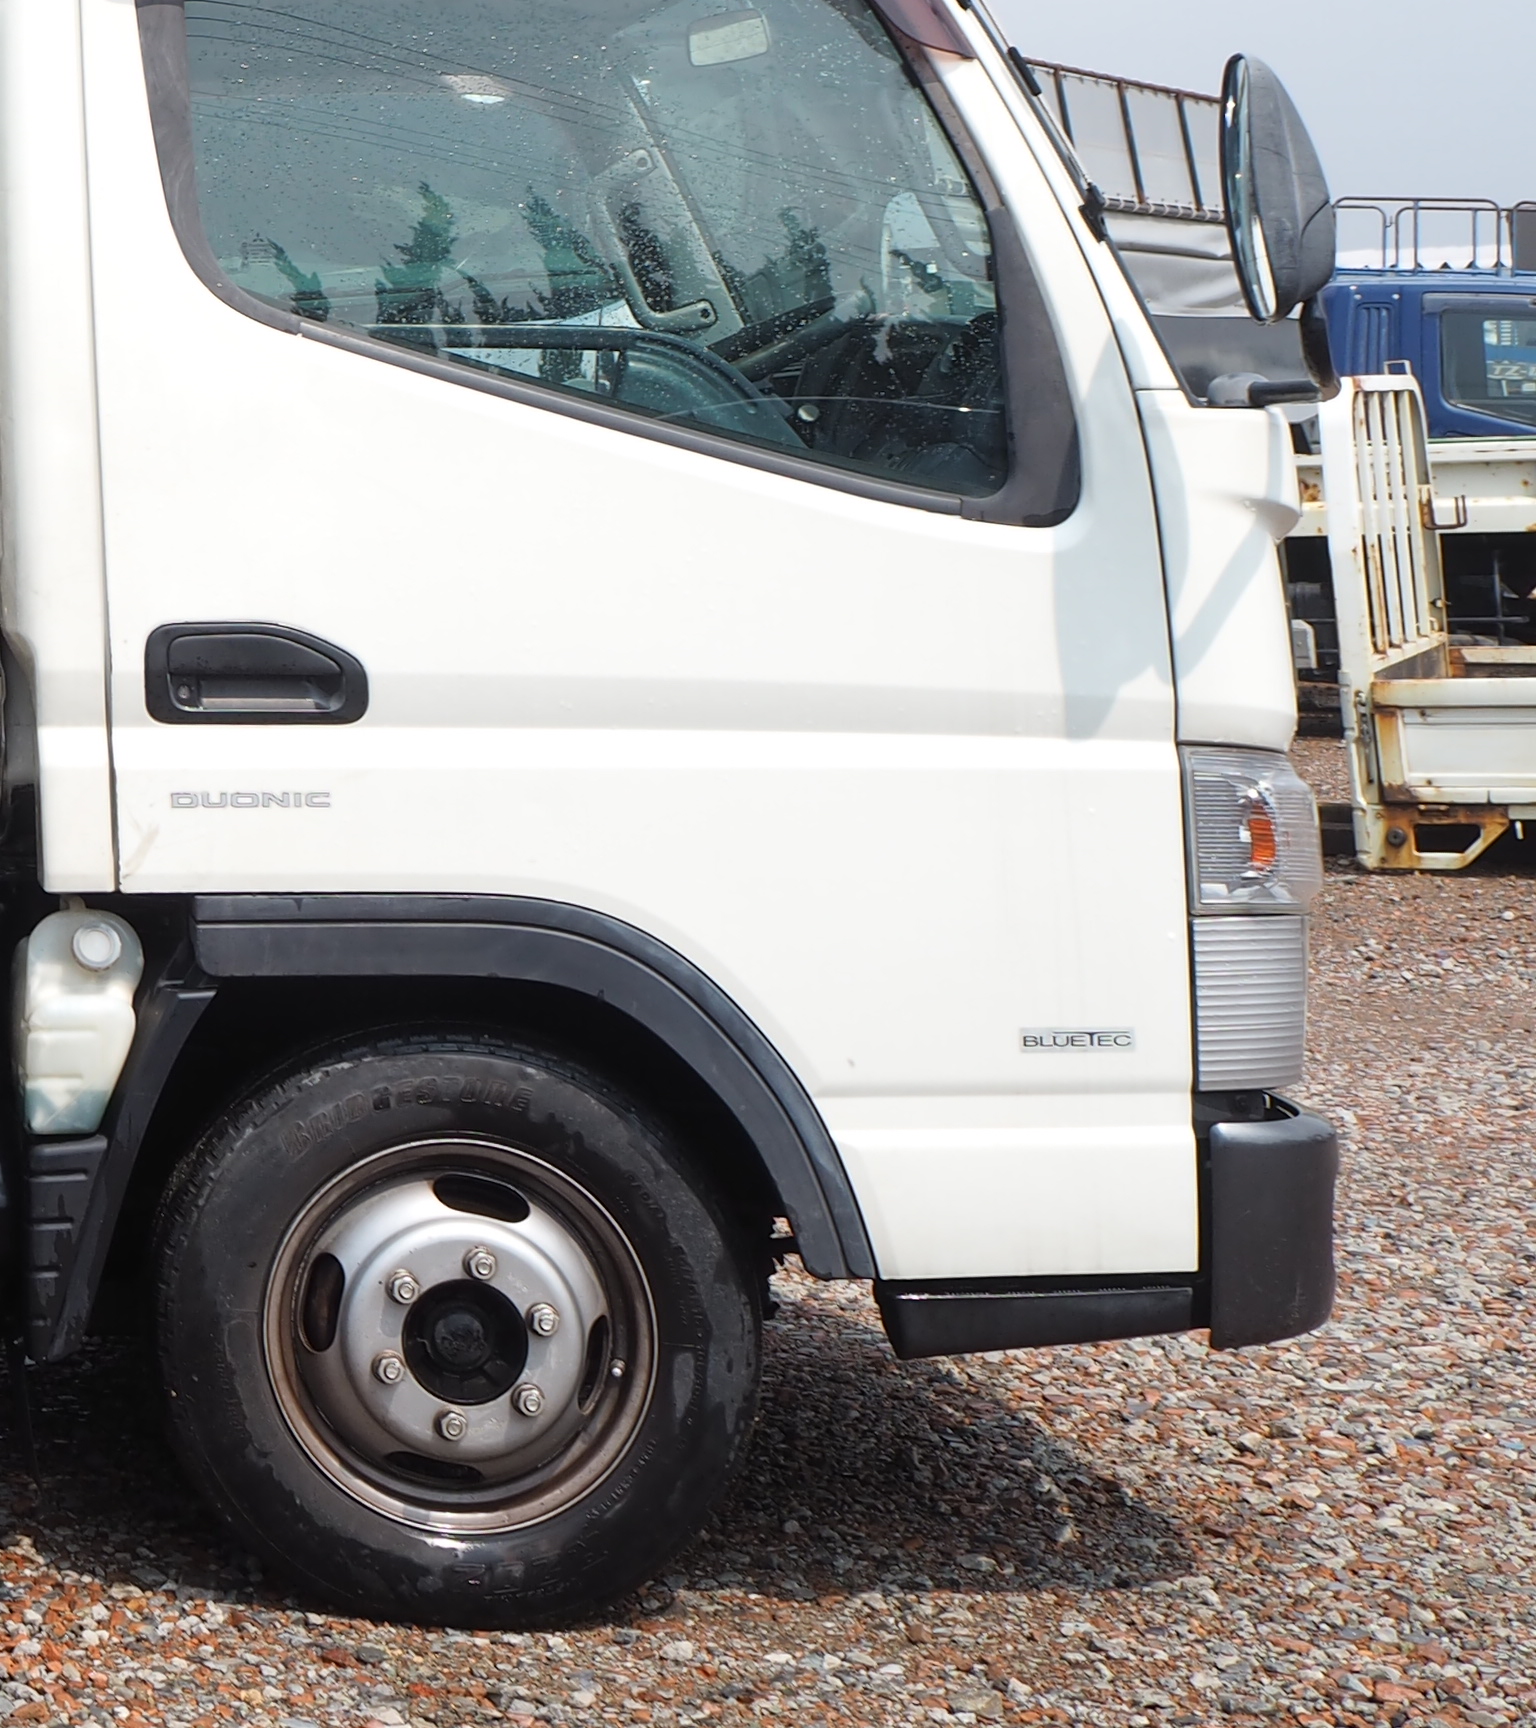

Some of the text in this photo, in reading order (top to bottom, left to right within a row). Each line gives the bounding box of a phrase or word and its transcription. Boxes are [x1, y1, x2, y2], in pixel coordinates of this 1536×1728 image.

[170, 791, 331, 809] DUONIC
[1022, 1030, 1132, 1048] BLUETEC
[281, 1075, 534, 1161] BRIDGESTONE
